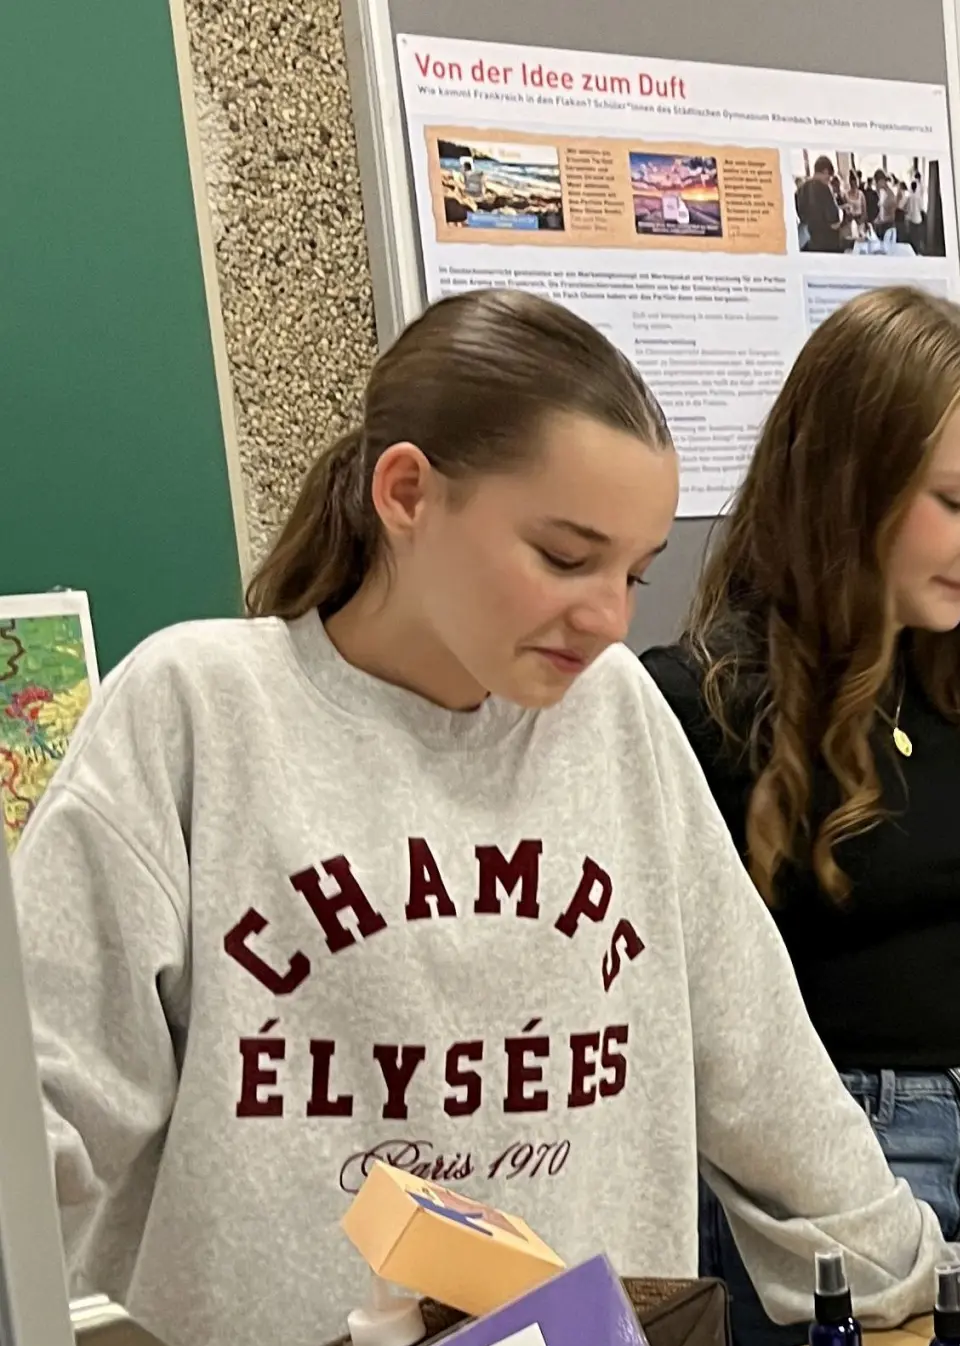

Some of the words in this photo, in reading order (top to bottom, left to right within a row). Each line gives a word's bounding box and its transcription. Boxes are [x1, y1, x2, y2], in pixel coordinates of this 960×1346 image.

[414, 52, 462, 82] Von
[471, 58, 513, 86] der
[522, 62, 574, 91] Idee
[583, 74, 631, 95] zum
[639, 72, 687, 100] Duft
[474, 89, 524, 104] Frankreich
[223, 836, 645, 996] CHAMPS
[235, 1017, 629, 1121] ÉLYSÉES
[339, 1138, 474, 1196] Paris
[486, 1138, 571, 1181] 1970
